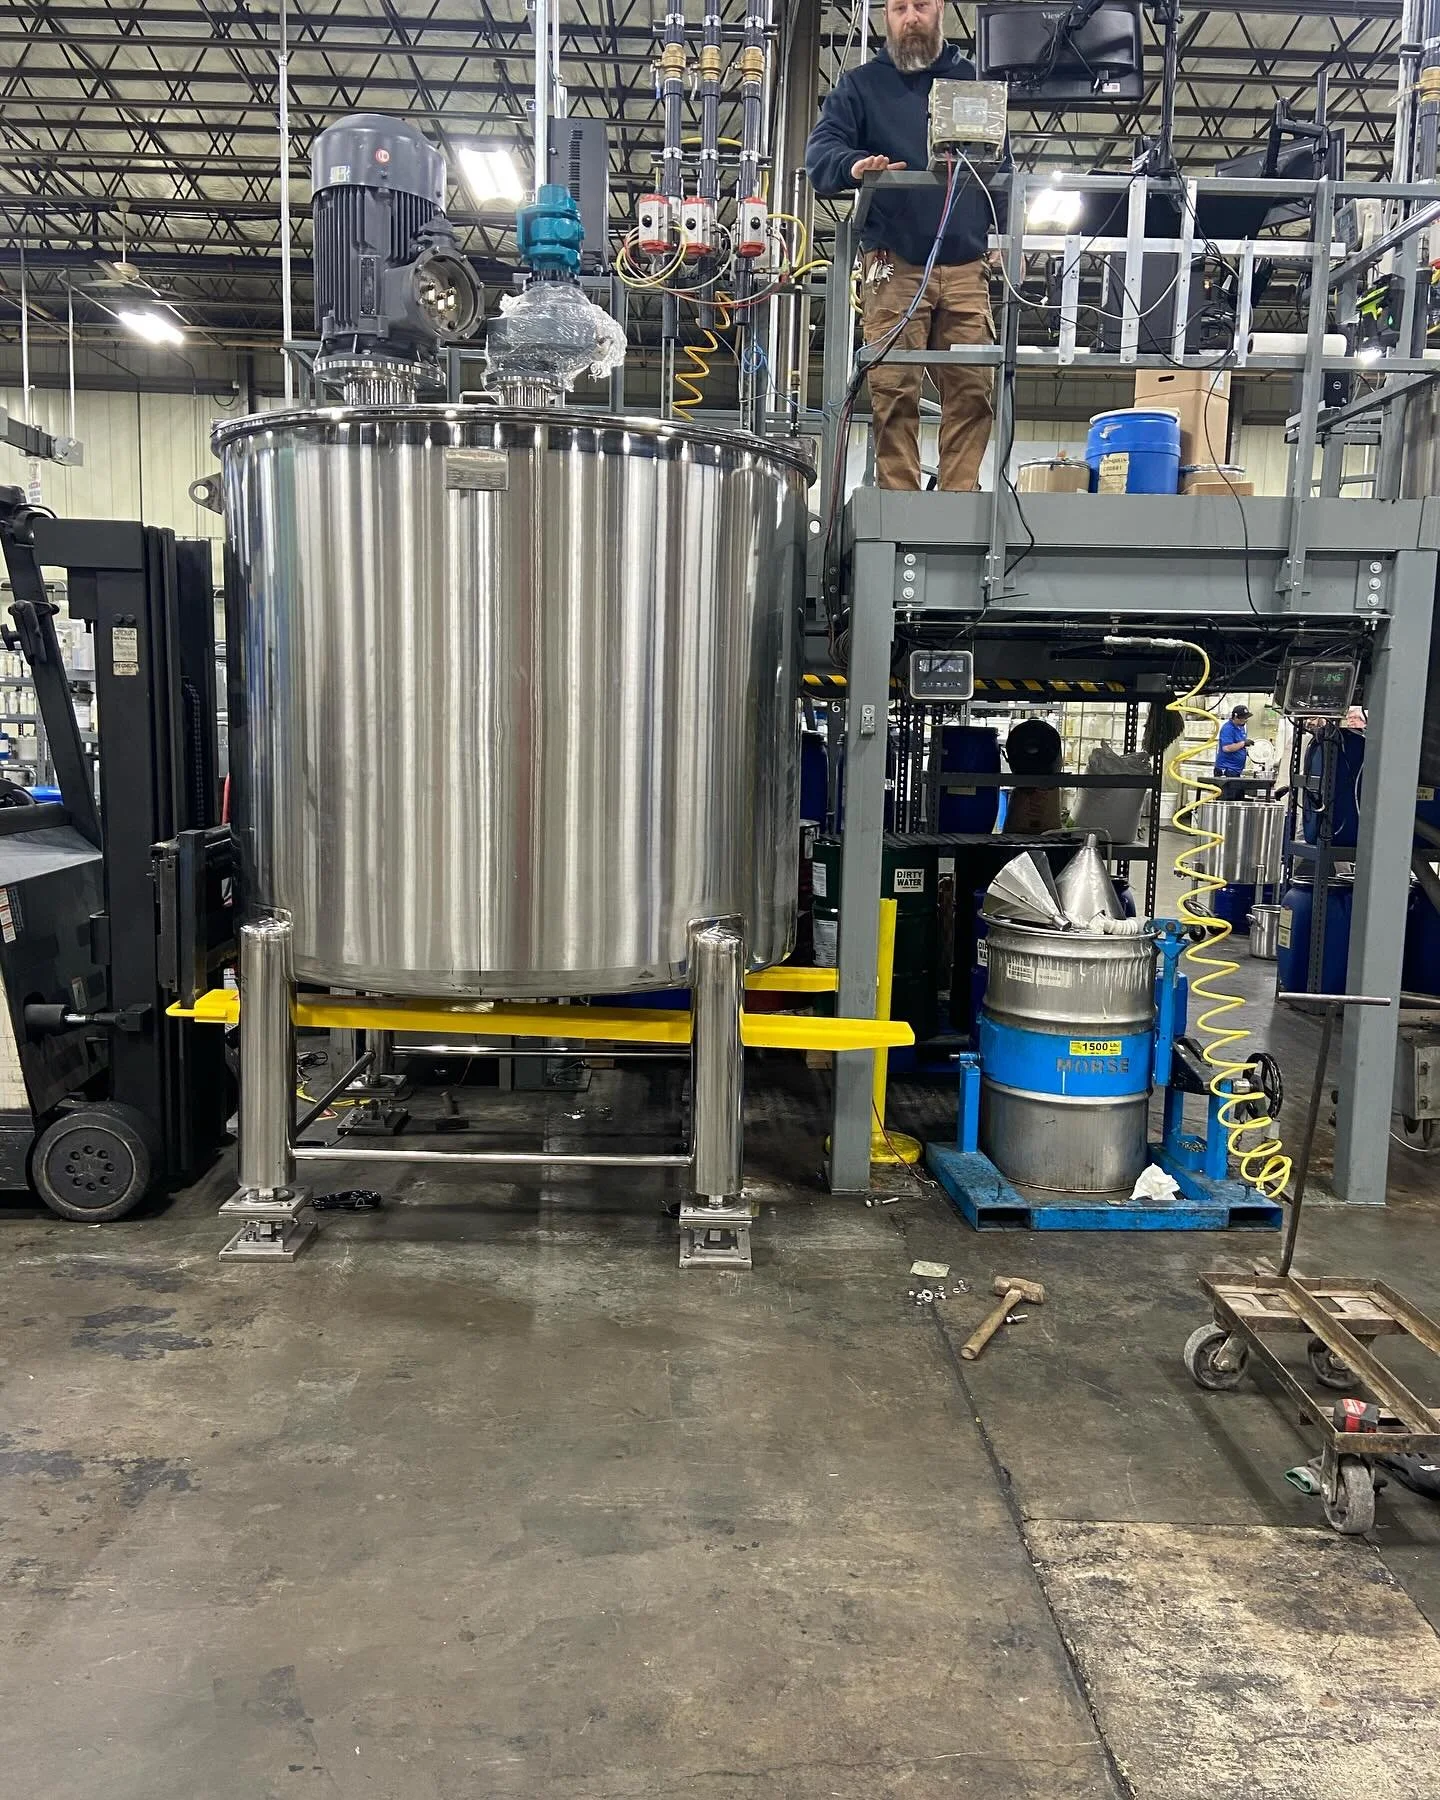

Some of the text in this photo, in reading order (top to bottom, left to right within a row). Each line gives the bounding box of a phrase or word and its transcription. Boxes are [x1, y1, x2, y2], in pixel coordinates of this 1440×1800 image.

[897, 871, 922, 879] DIRTY
[1082, 1042, 1109, 1051] 1500
[1056, 1057, 1129, 1073] MORSE
